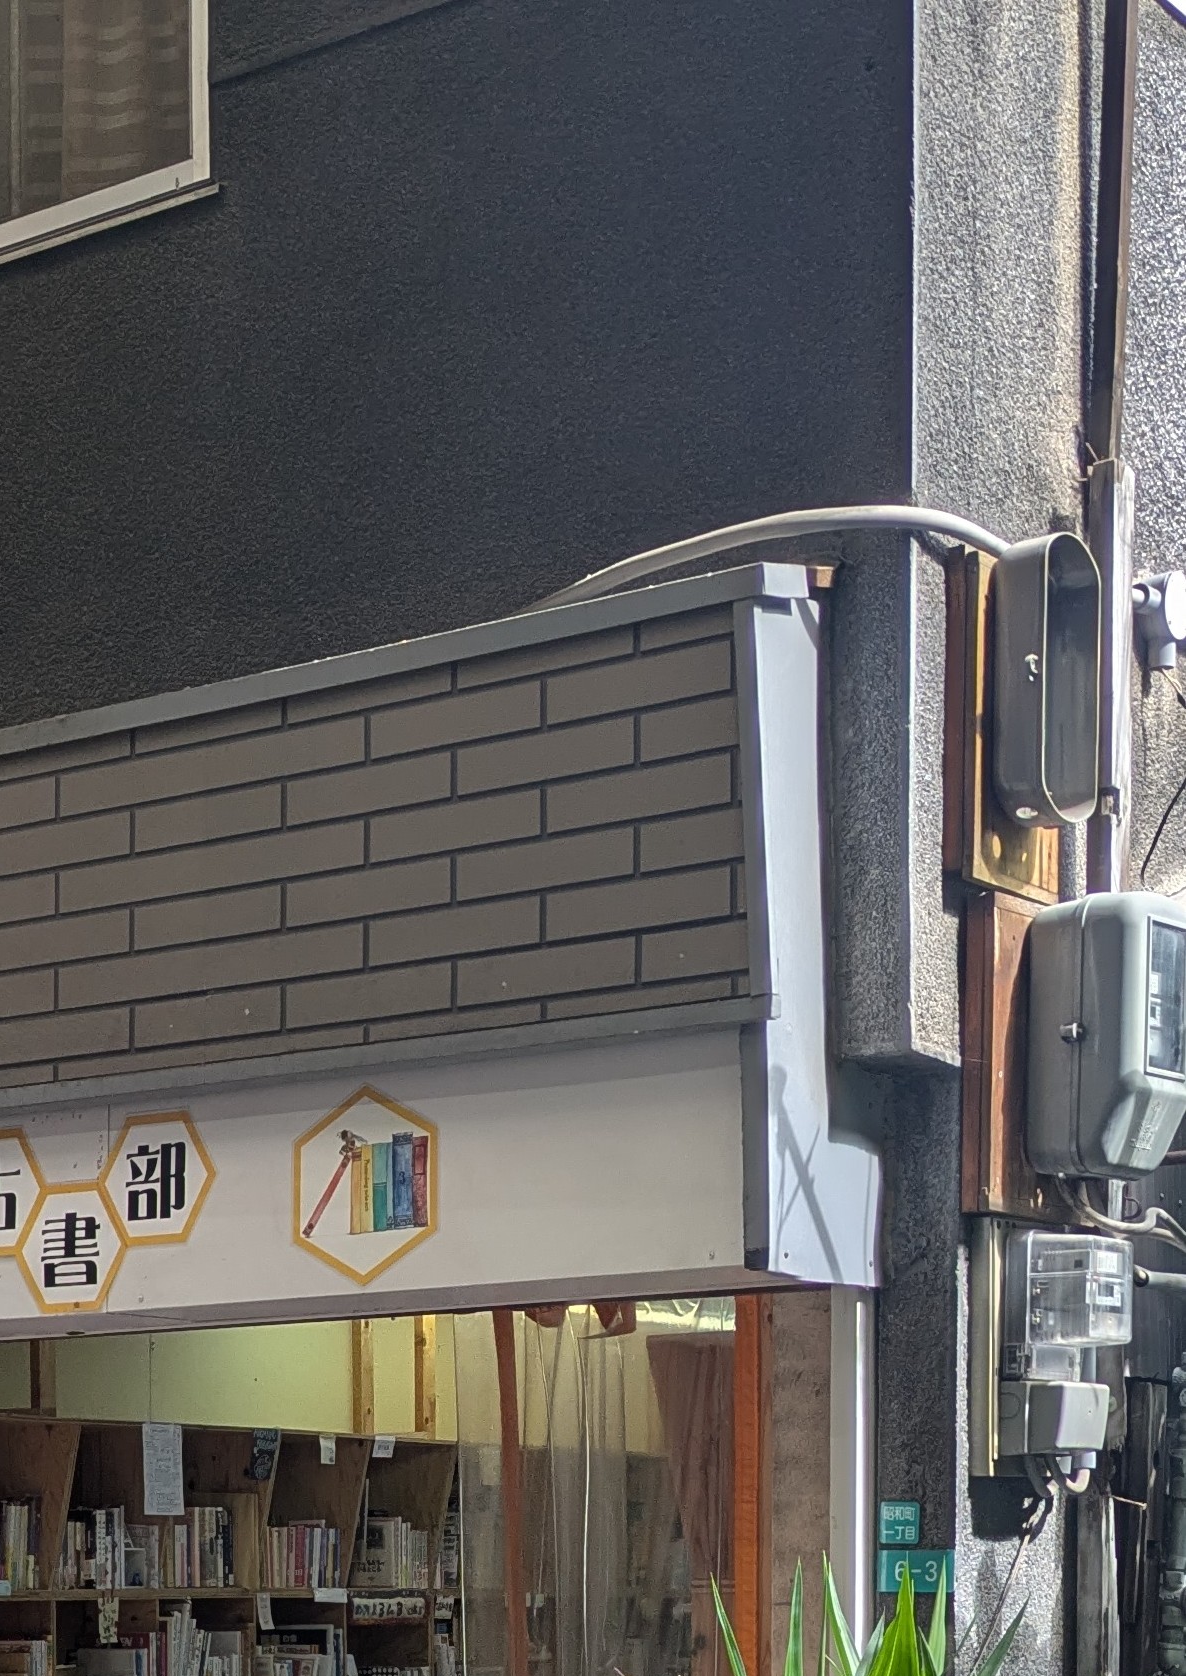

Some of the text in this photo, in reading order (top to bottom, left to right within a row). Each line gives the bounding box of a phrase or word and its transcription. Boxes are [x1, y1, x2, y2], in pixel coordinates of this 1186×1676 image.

[883, 1506, 916, 1521] 昭和町
[883, 1526, 915, 1540] 一丁目
[894, 1561, 937, 1582] 6-3
